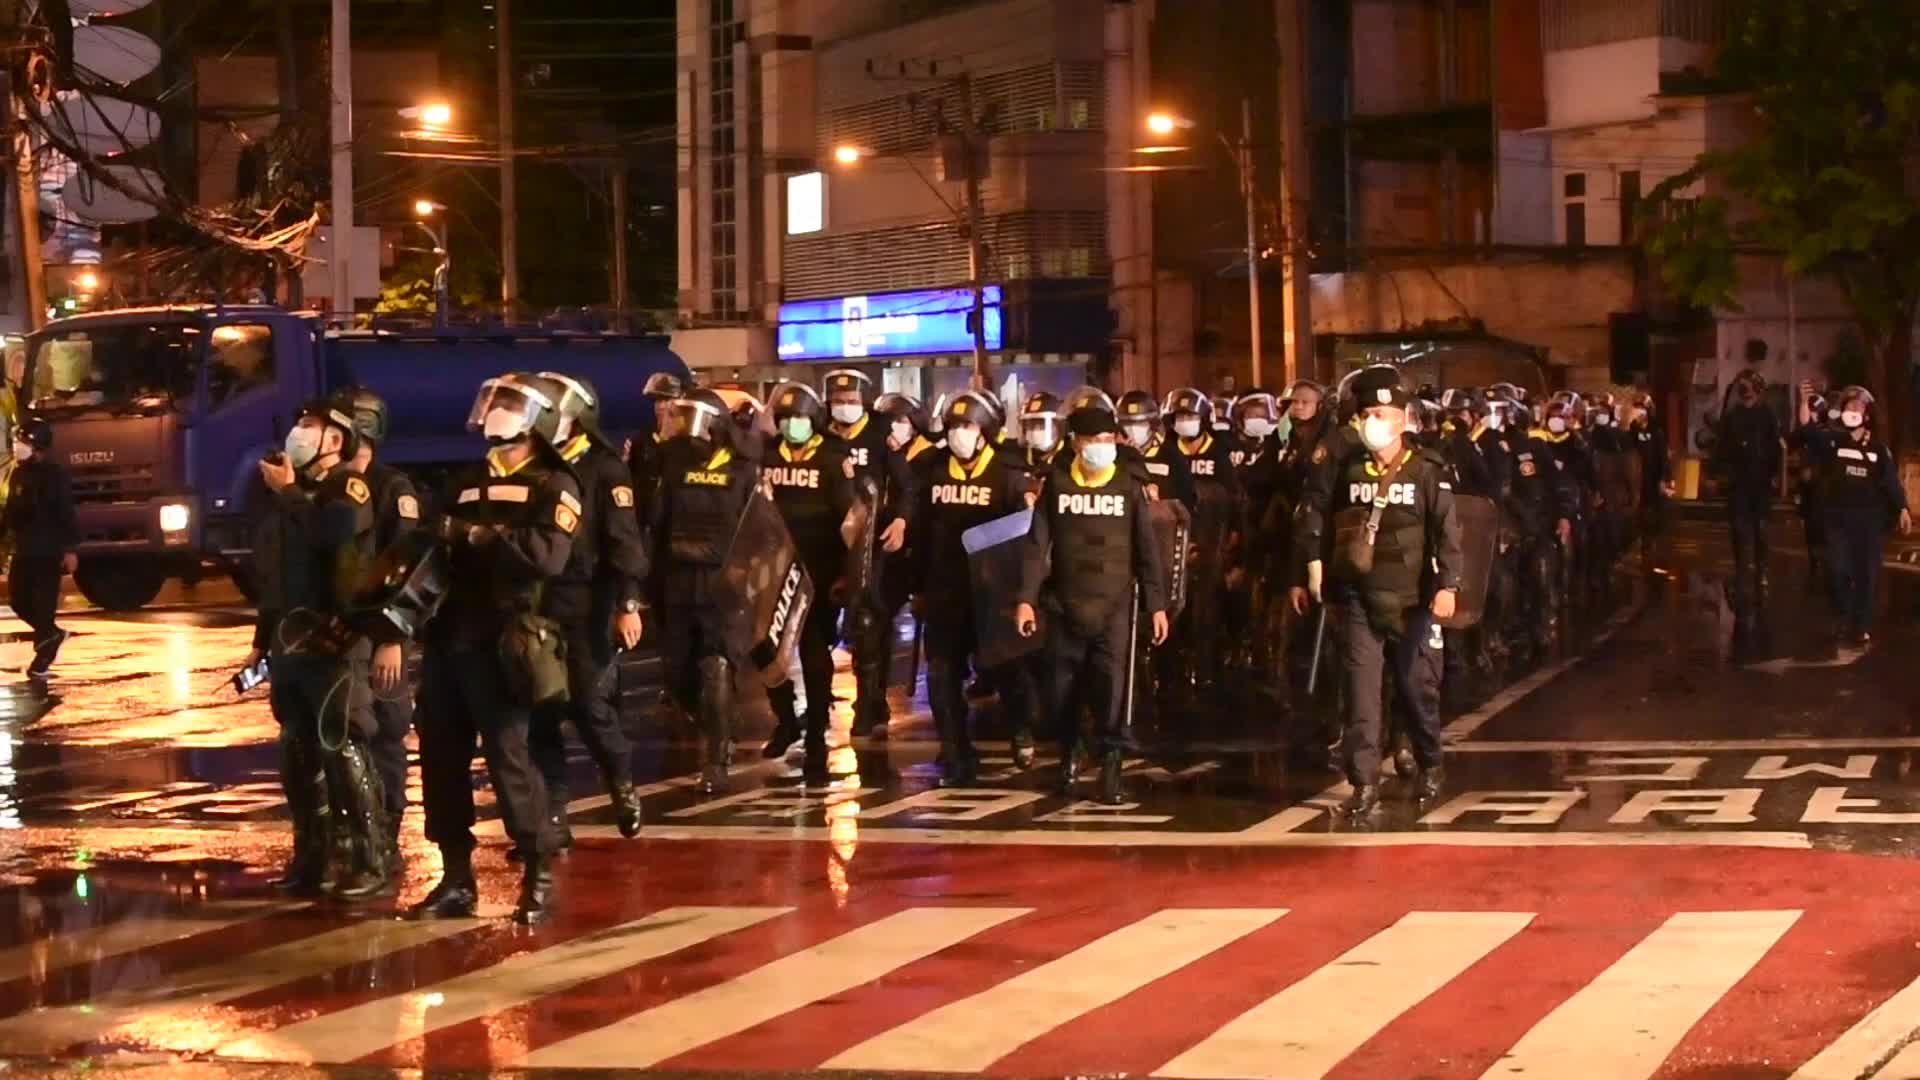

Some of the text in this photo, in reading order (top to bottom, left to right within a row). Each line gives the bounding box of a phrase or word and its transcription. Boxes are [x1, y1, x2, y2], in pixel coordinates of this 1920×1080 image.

[70, 451, 114, 464] ISUZU
[686, 471, 727, 485] POLICE
[764, 467, 819, 488] POLICE
[932, 485, 991, 505] POLICE
[1350, 482, 1415, 504] POLCE
[1058, 494, 1124, 516] POLICE
[769, 563, 800, 647] POLICE
